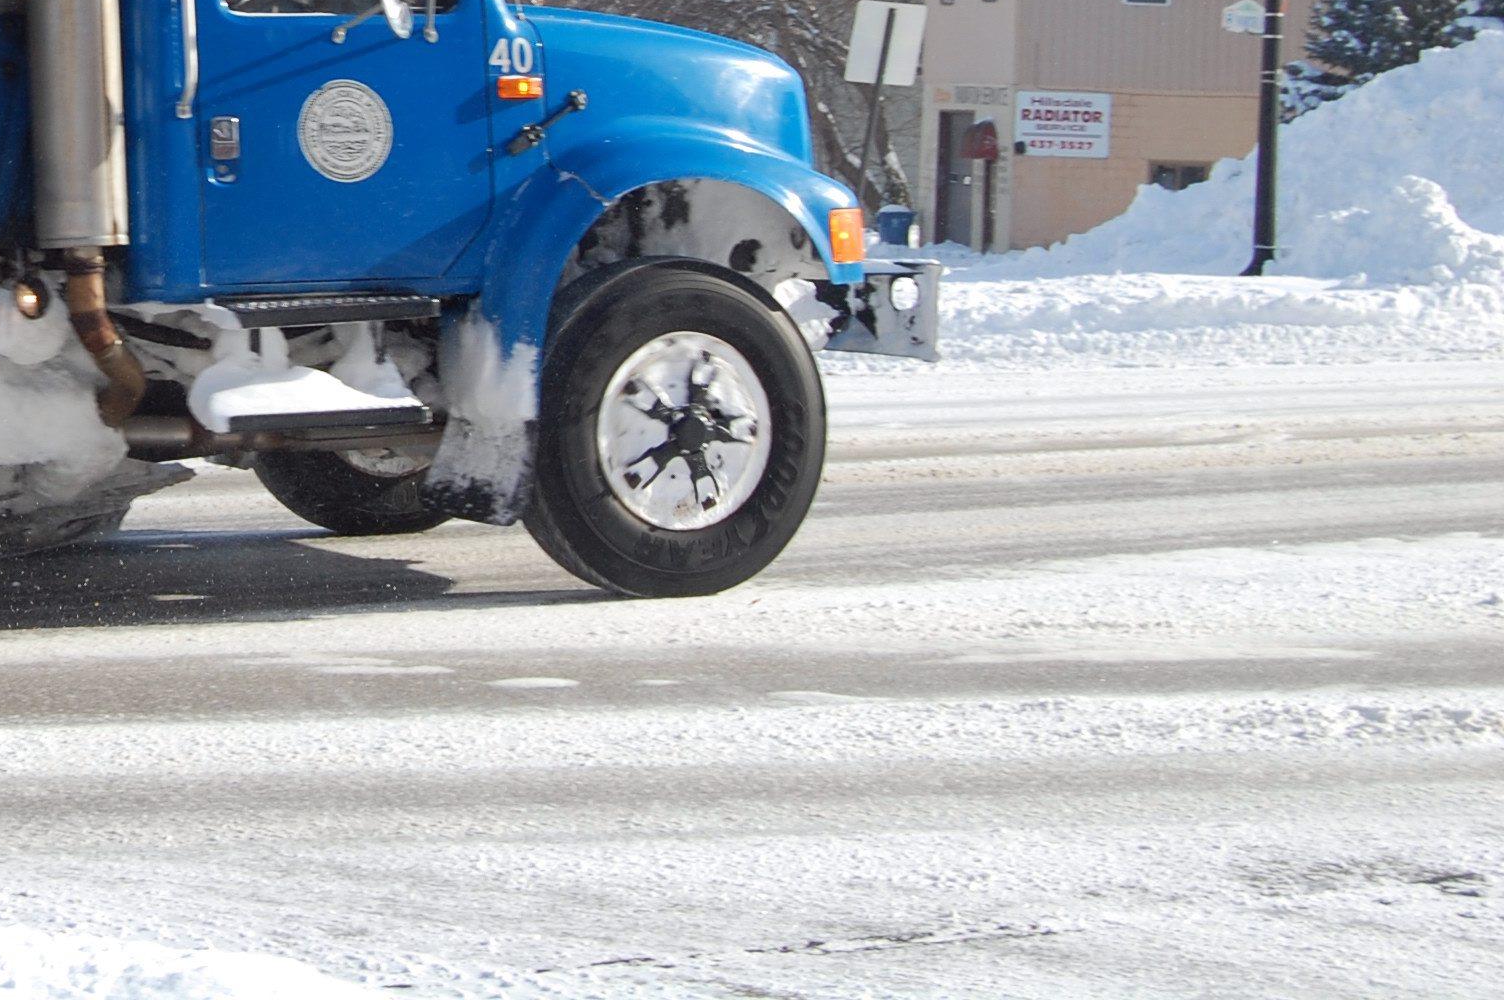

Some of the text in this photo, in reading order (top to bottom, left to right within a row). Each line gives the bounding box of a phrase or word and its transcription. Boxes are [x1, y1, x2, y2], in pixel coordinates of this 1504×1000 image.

[488, 37, 534, 73] 40
[1030, 96, 1093, 108] Hillsdale
[1020, 108, 1103, 123] RADIATOR
